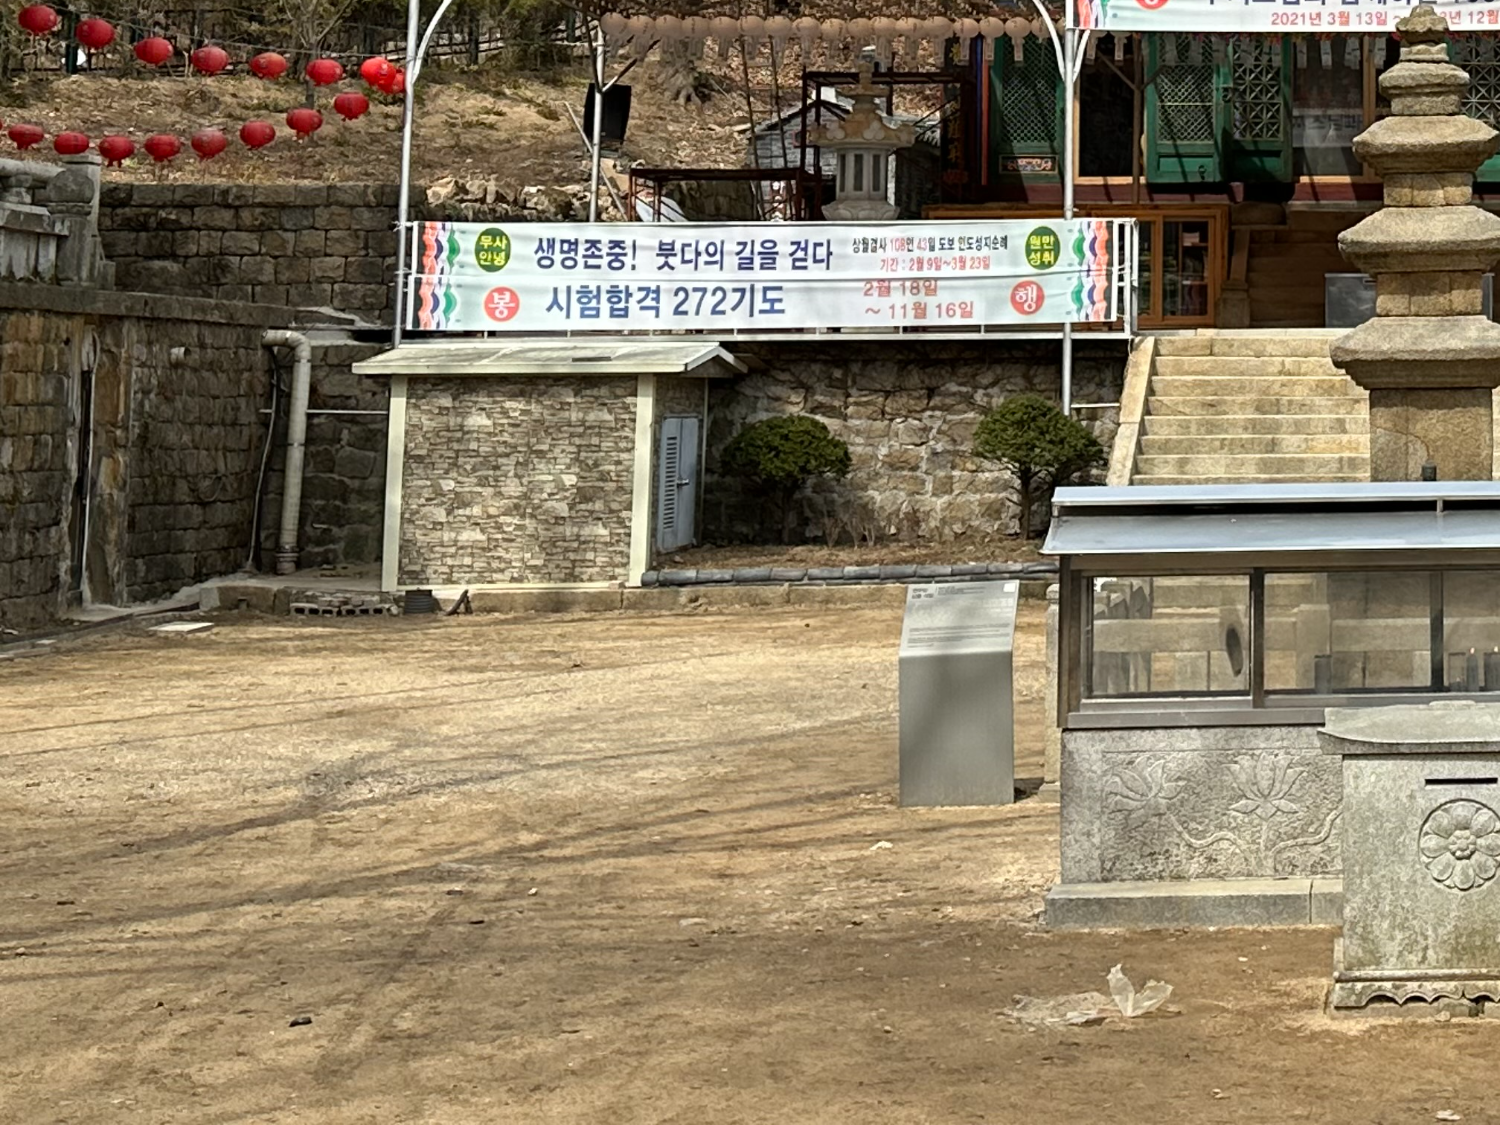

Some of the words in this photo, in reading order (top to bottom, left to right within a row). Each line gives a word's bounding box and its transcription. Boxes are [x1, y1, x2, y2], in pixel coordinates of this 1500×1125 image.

[1271, 11, 1322, 26] 2021년
[1327, 11, 1350, 26] 3월
[1356, 11, 1388, 26] 13일
[1468, 9, 1499, 24] 12월
[479, 235, 507, 250] 무사
[852, 237, 887, 253] 상월결사
[890, 237, 914, 252] 108인
[916, 237, 936, 252] 43일
[938, 236, 955, 251] 도보
[957, 235, 1008, 251] 인도성지순례
[1029, 235, 1055, 249] 원만
[479, 251, 506, 266] 안녕
[534, 237, 637, 271] 생명존중!
[656, 238, 725, 271] 붓다의
[735, 238, 779, 271] 길을
[788, 238, 833, 271] 걷다
[1028, 251, 1055, 266] 성취
[880, 257, 898, 272] 기간
[908, 256, 924, 271] 2월
[969, 255, 990, 270] 23일
[863, 279, 891, 297] 2월
[899, 279, 937, 296] 18일
[488, 291, 516, 319] 봉
[546, 285, 661, 319] 시험합격
[672, 284, 785, 318] 272기도
[1014, 284, 1038, 312] 행
[889, 301, 927, 319] 11월
[935, 301, 974, 319] 16일
